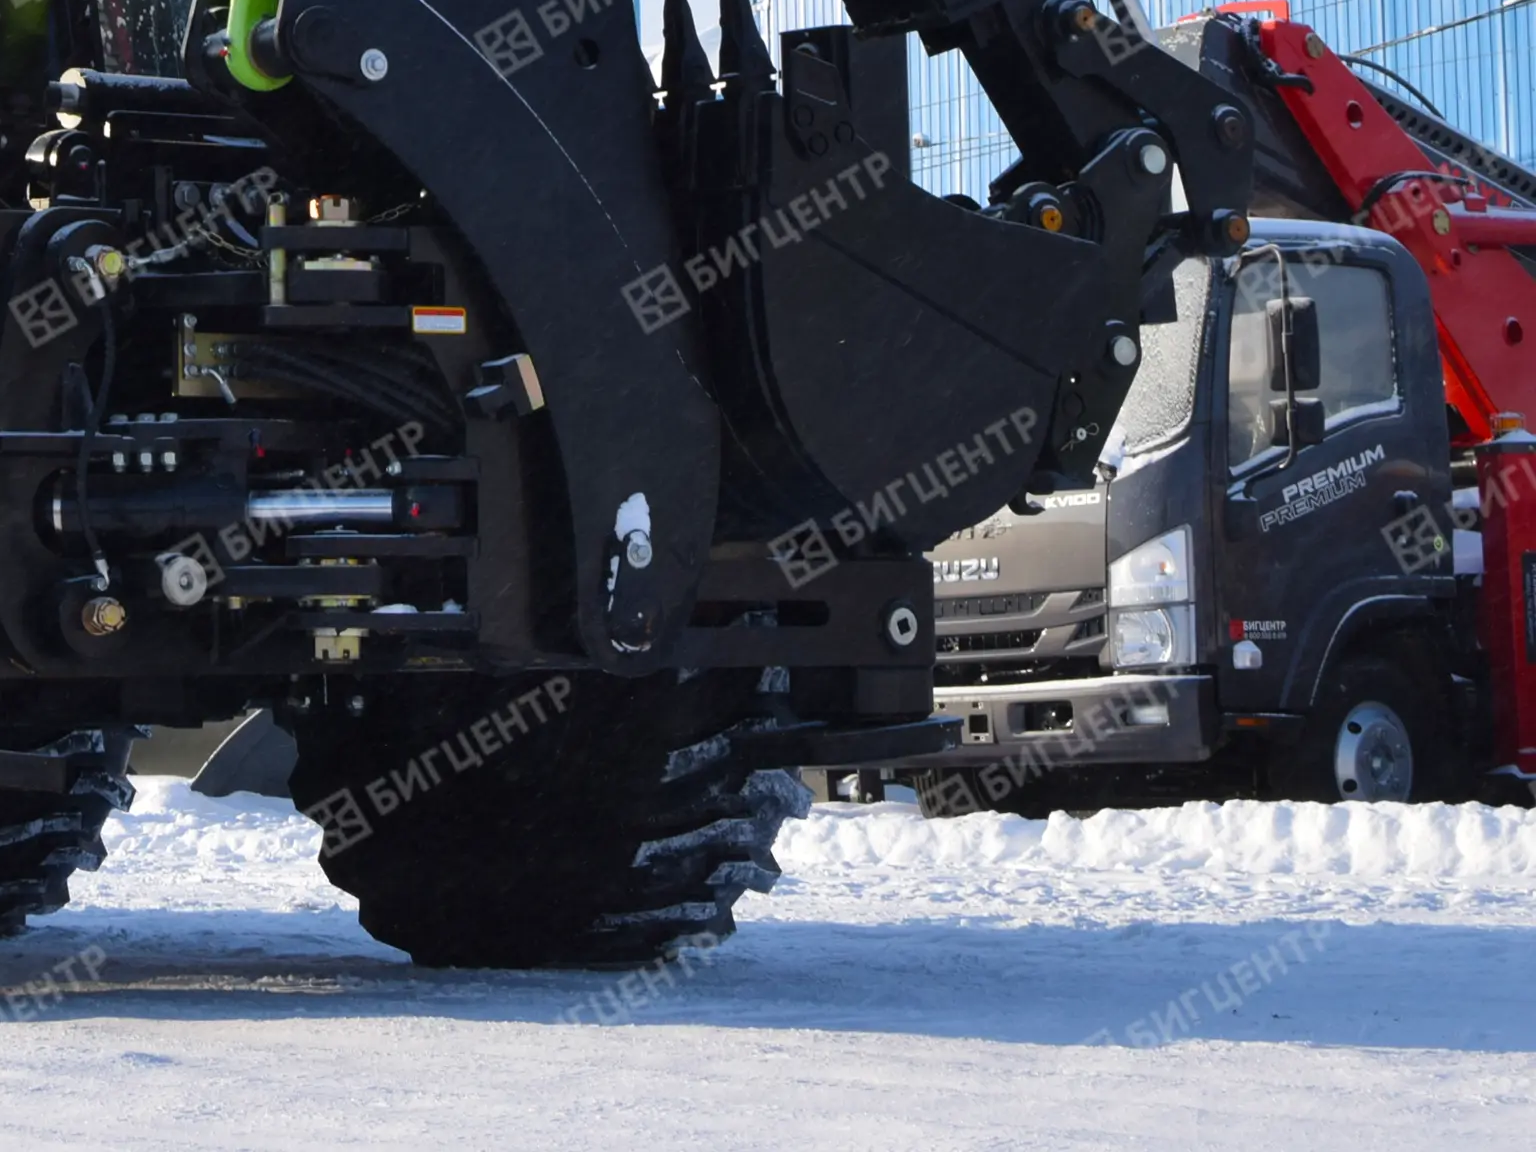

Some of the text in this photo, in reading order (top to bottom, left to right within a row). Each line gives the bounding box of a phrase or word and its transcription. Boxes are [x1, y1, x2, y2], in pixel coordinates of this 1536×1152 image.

[1260, 469, 1366, 532] PREMIUM
[1282, 444, 1385, 503] PREMIUM
[1242, 620, 1287, 632] БИГЦЕНТР
